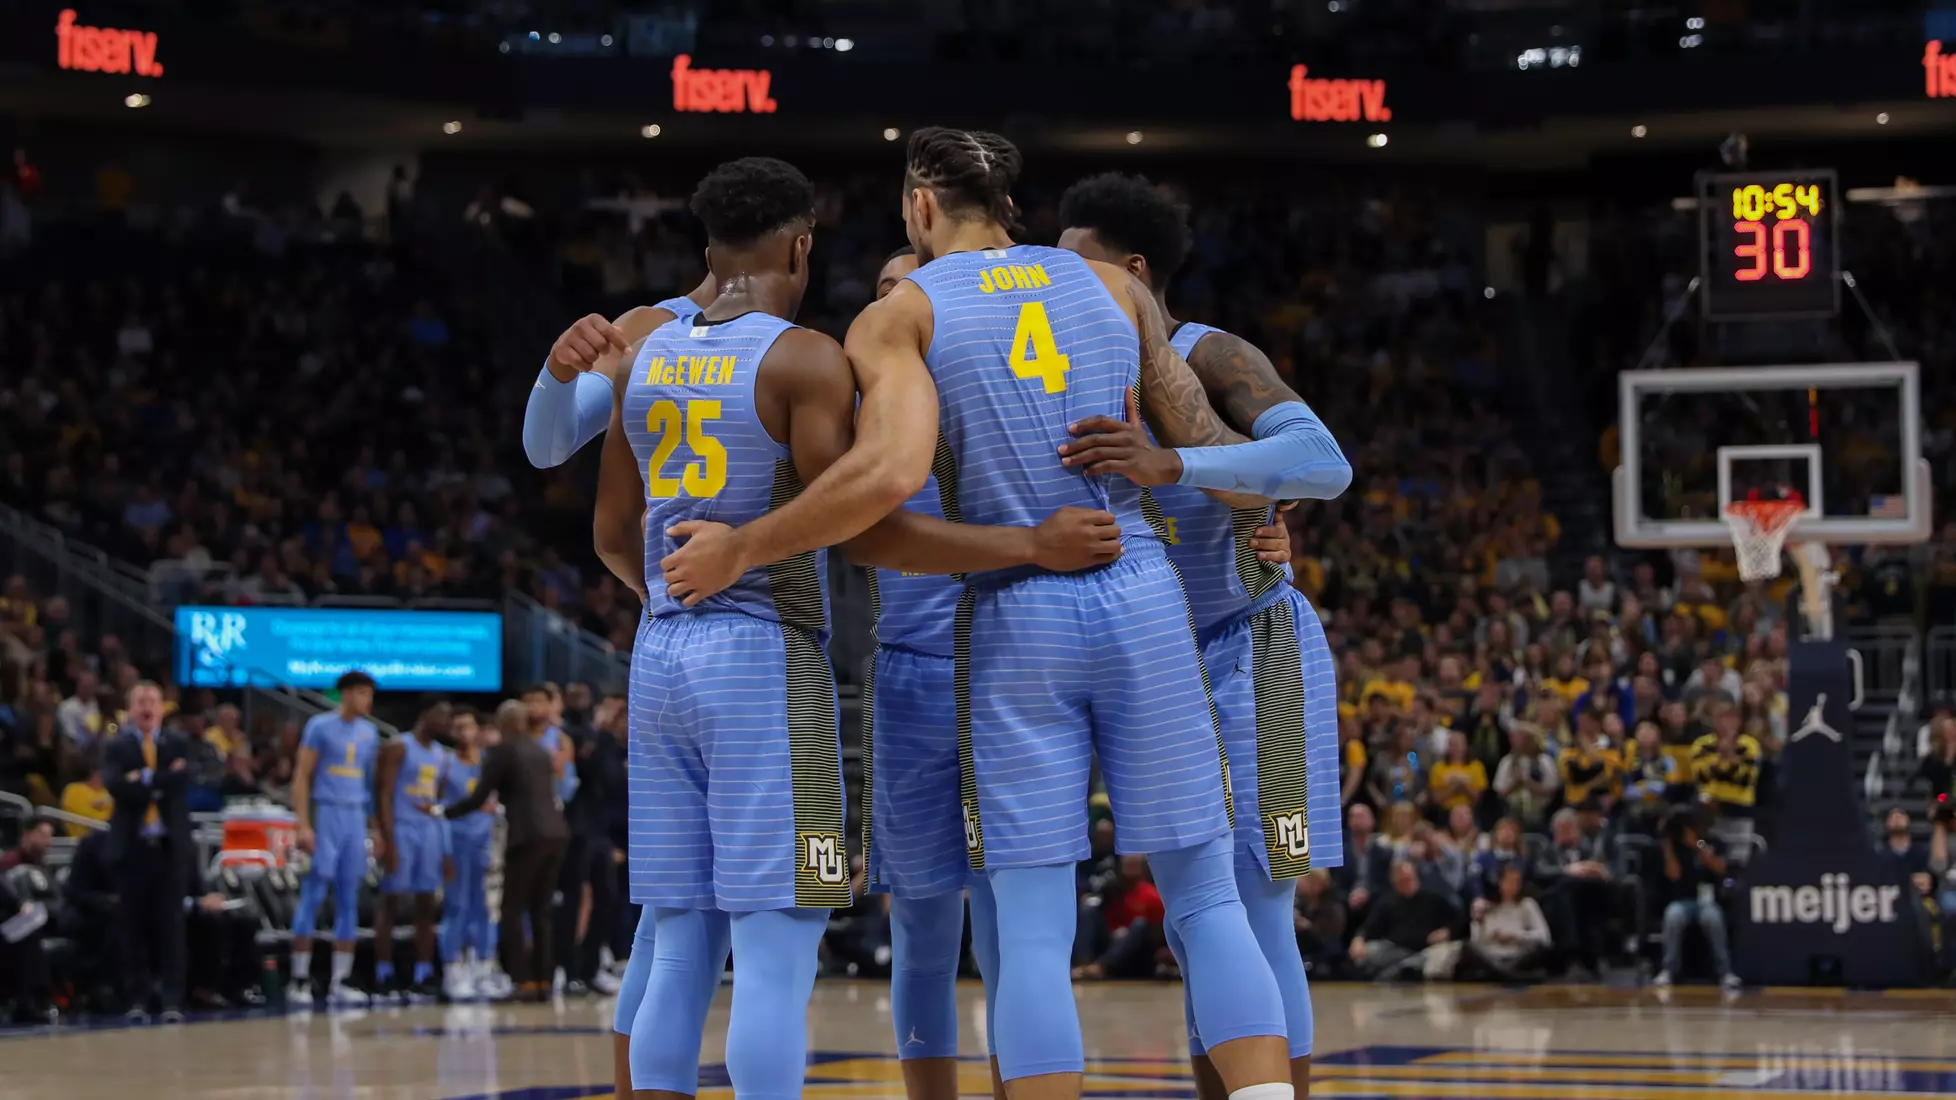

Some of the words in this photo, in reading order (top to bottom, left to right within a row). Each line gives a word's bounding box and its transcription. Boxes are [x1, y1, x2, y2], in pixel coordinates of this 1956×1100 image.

[1733, 183, 1820, 221] 10:54
[1734, 219, 1811, 281] 30
[979, 263, 1051, 294] JOHN
[646, 355, 737, 386] McEWEN
[1008, 301, 1071, 394] 4
[646, 399, 728, 498] 25
[803, 834, 846, 885] MU
[1271, 809, 1310, 860] MU
[1750, 872, 1900, 934] meijer
